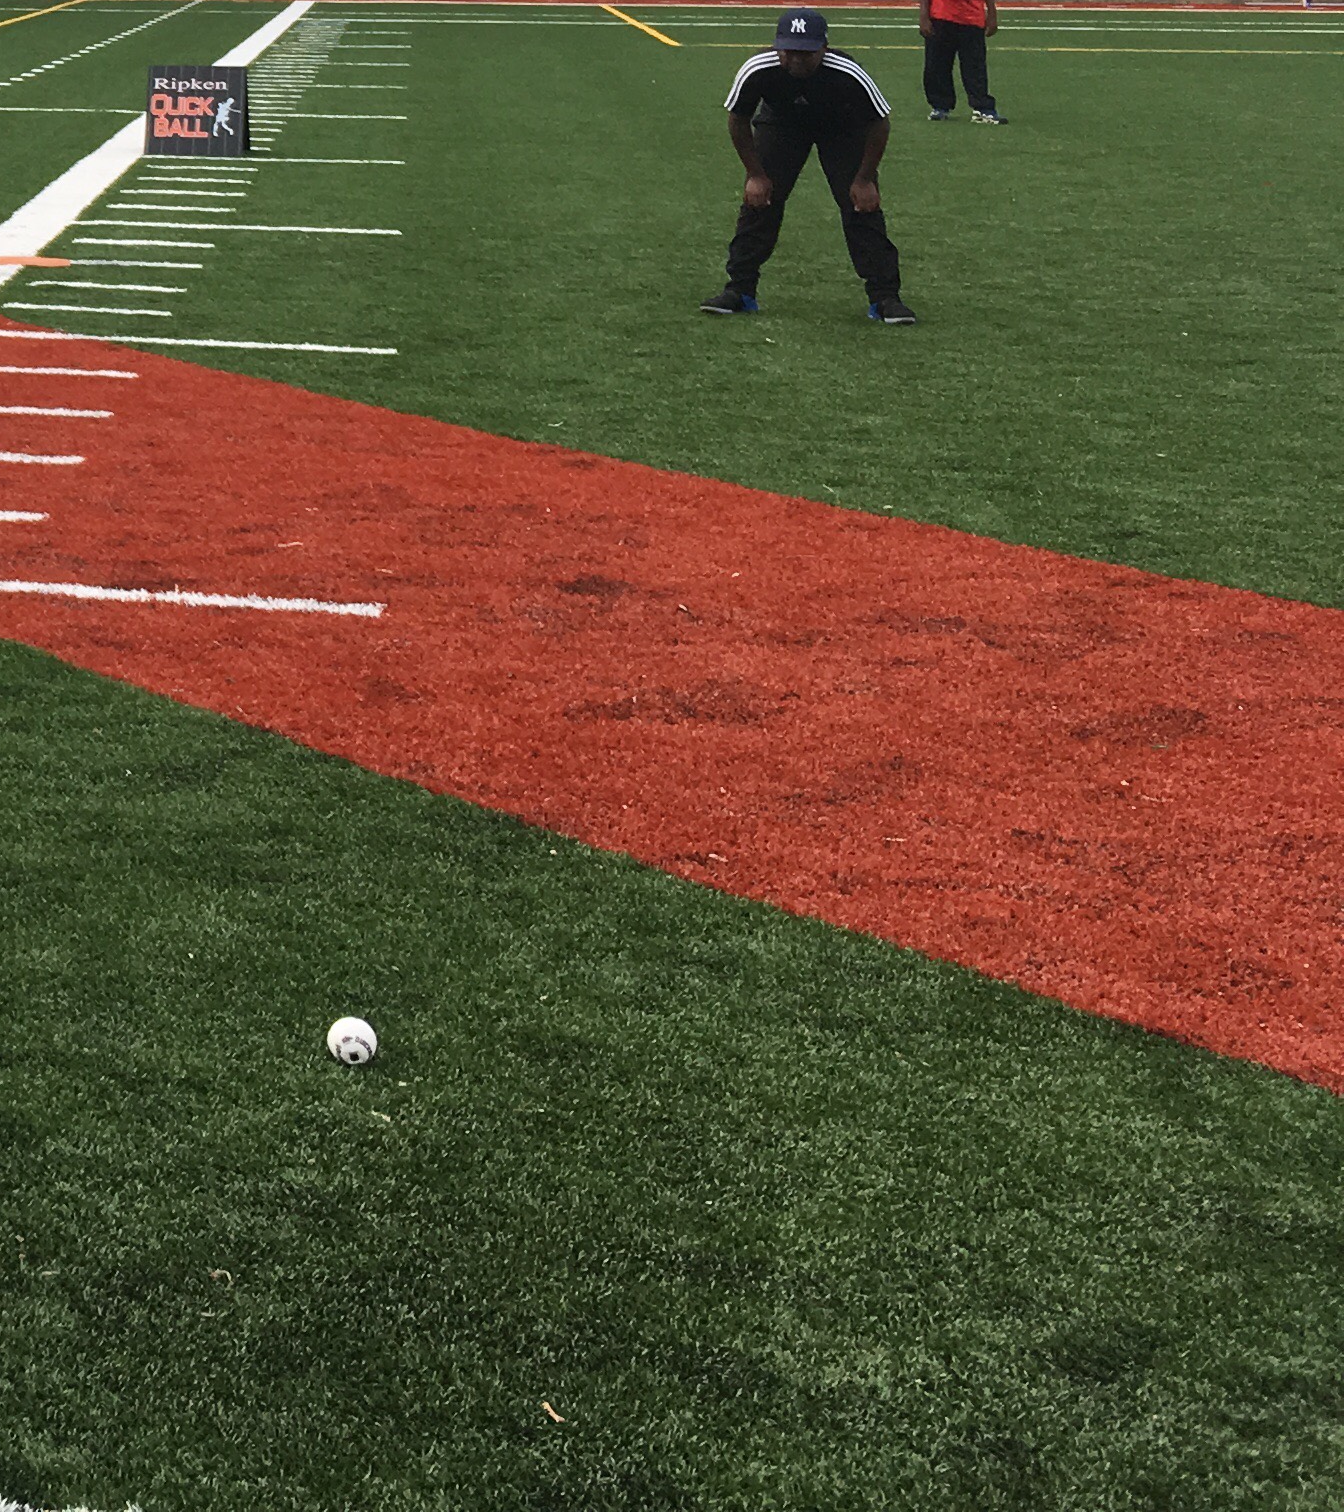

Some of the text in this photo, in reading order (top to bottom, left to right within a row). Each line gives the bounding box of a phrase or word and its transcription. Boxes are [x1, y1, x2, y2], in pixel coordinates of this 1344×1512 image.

[154, 77, 228, 92] Ripken
[151, 94, 214, 117] QUICK
[154, 118, 208, 137] BALL
